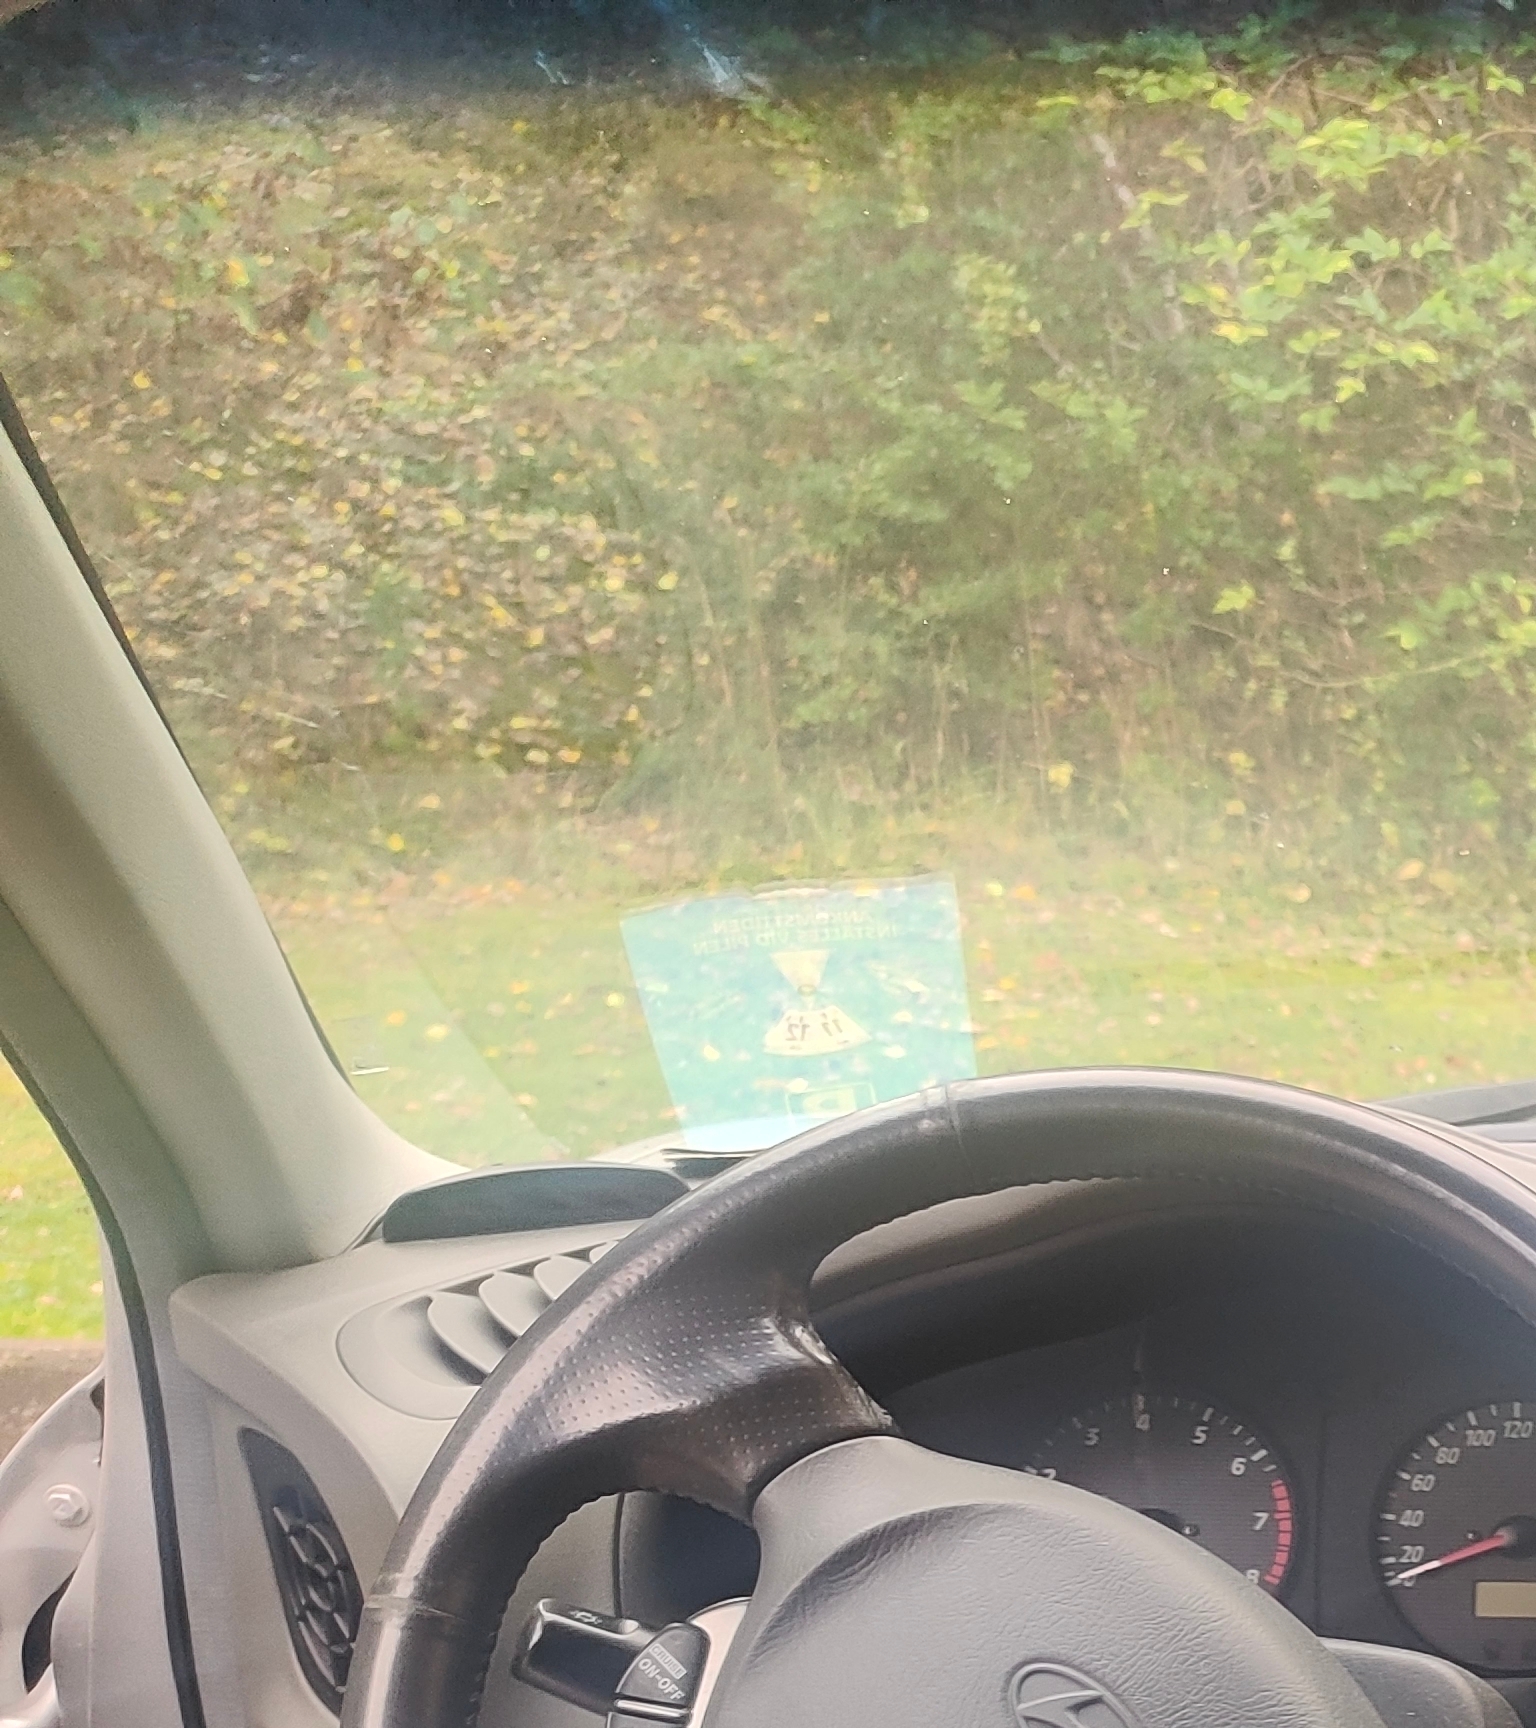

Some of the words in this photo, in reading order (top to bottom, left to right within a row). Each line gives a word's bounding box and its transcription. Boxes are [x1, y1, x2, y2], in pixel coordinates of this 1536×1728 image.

[1084, 1428, 1100, 1446] 3
[1191, 1425, 1208, 1445] 5
[1465, 1428, 1498, 1447] 100
[1503, 1420, 1534, 1439] 120
[1230, 1457, 1247, 1477] 6
[1410, 1473, 1436, 1492] 60
[1252, 1511, 1270, 1531] 7
[1399, 1509, 1425, 1528] 40
[1399, 1545, 1425, 1562] 20
[651, 1645, 686, 1678] CRUISE
[638, 1658, 685, 1700] ON-OFF
